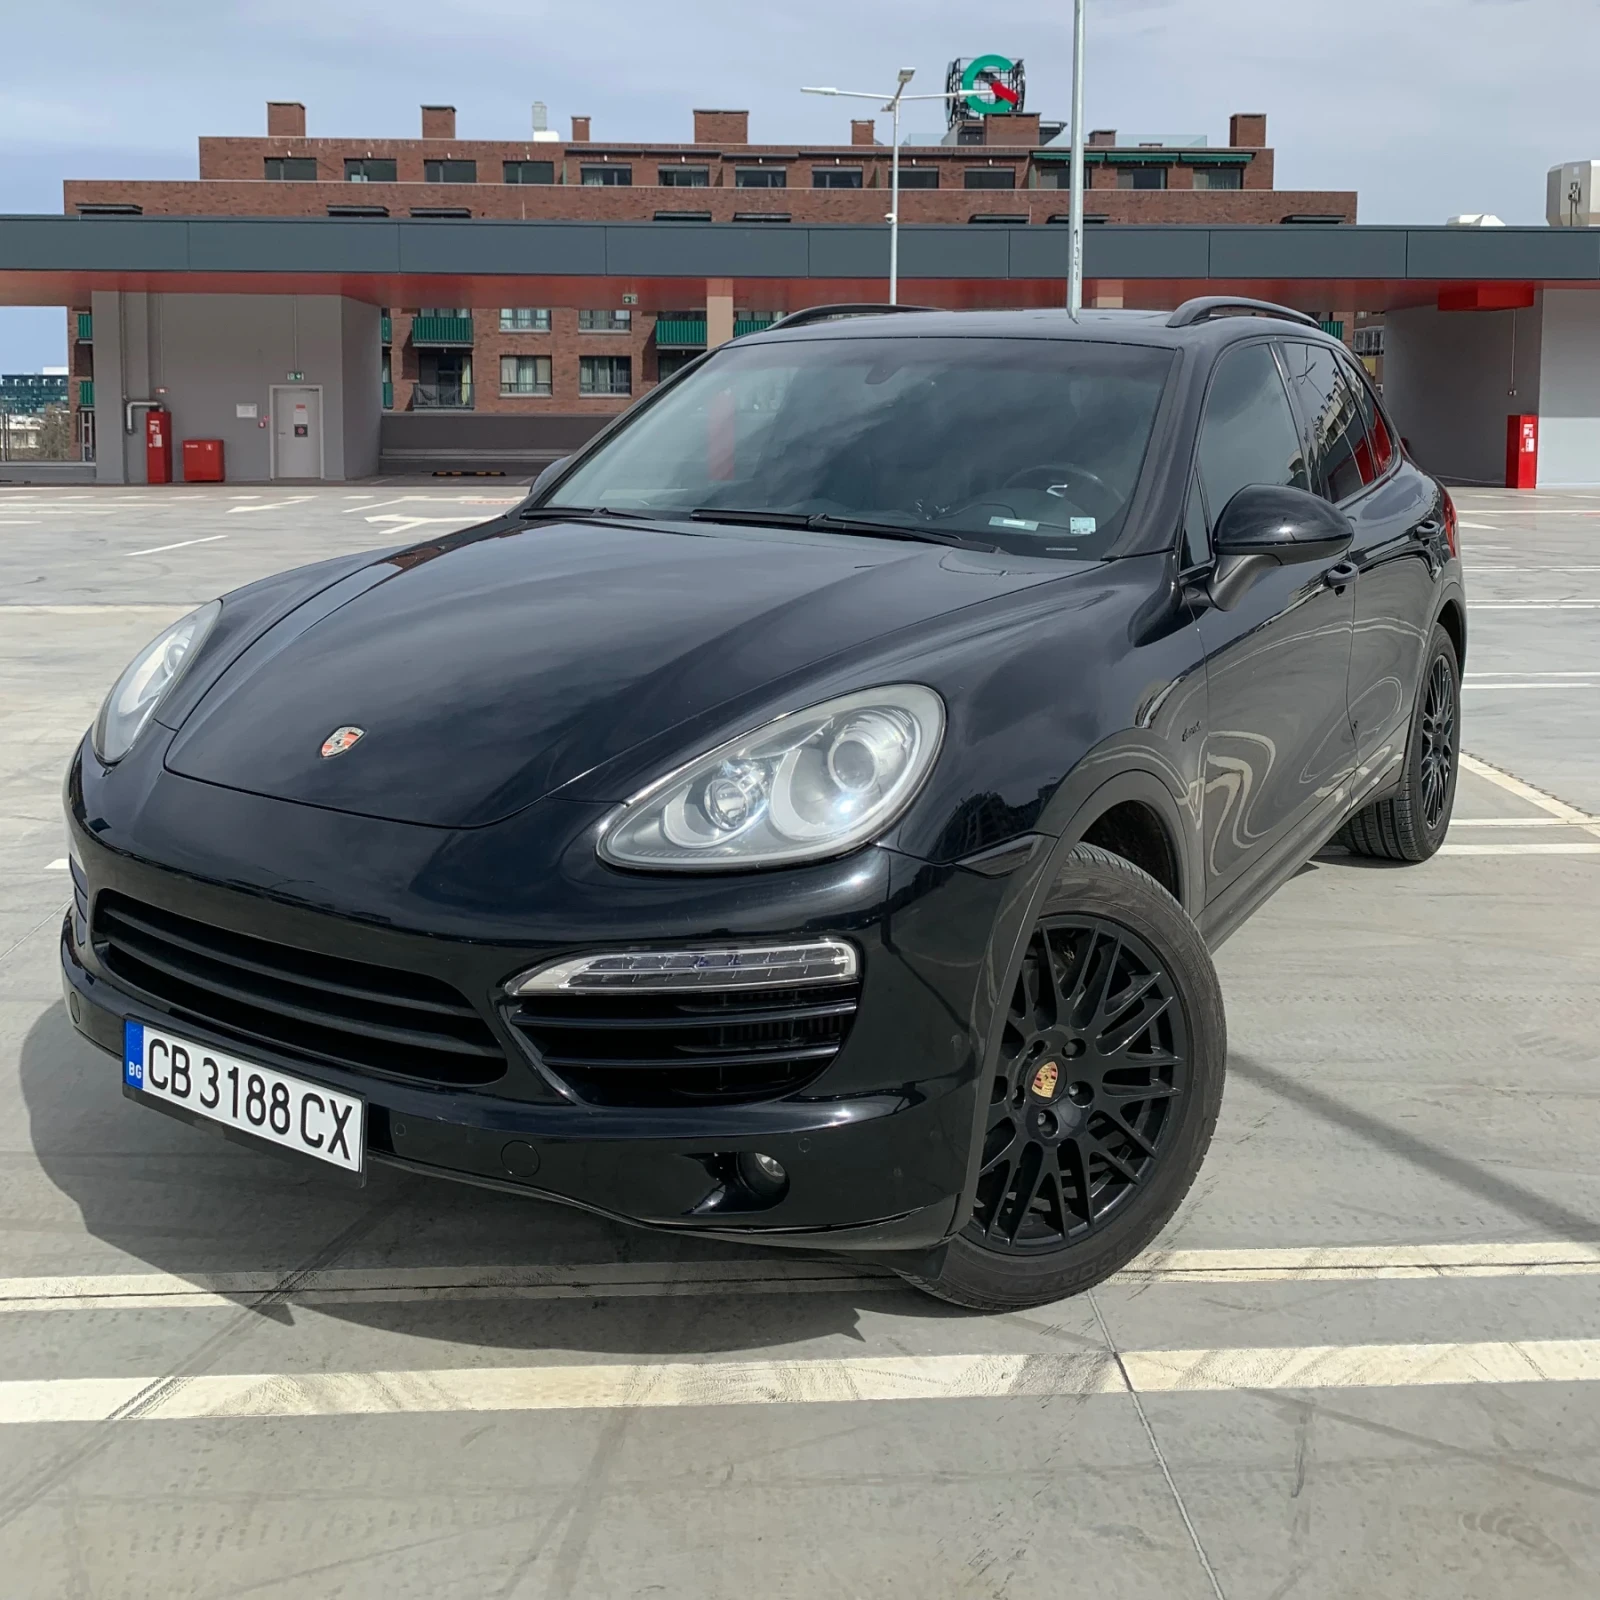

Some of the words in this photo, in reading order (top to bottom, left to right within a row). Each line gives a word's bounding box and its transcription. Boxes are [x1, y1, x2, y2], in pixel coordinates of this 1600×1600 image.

[128, 1060, 143, 1079] BG
[148, 1038, 192, 1099] CB
[200, 1057, 291, 1135] 3188
[300, 1092, 353, 1161] CX
